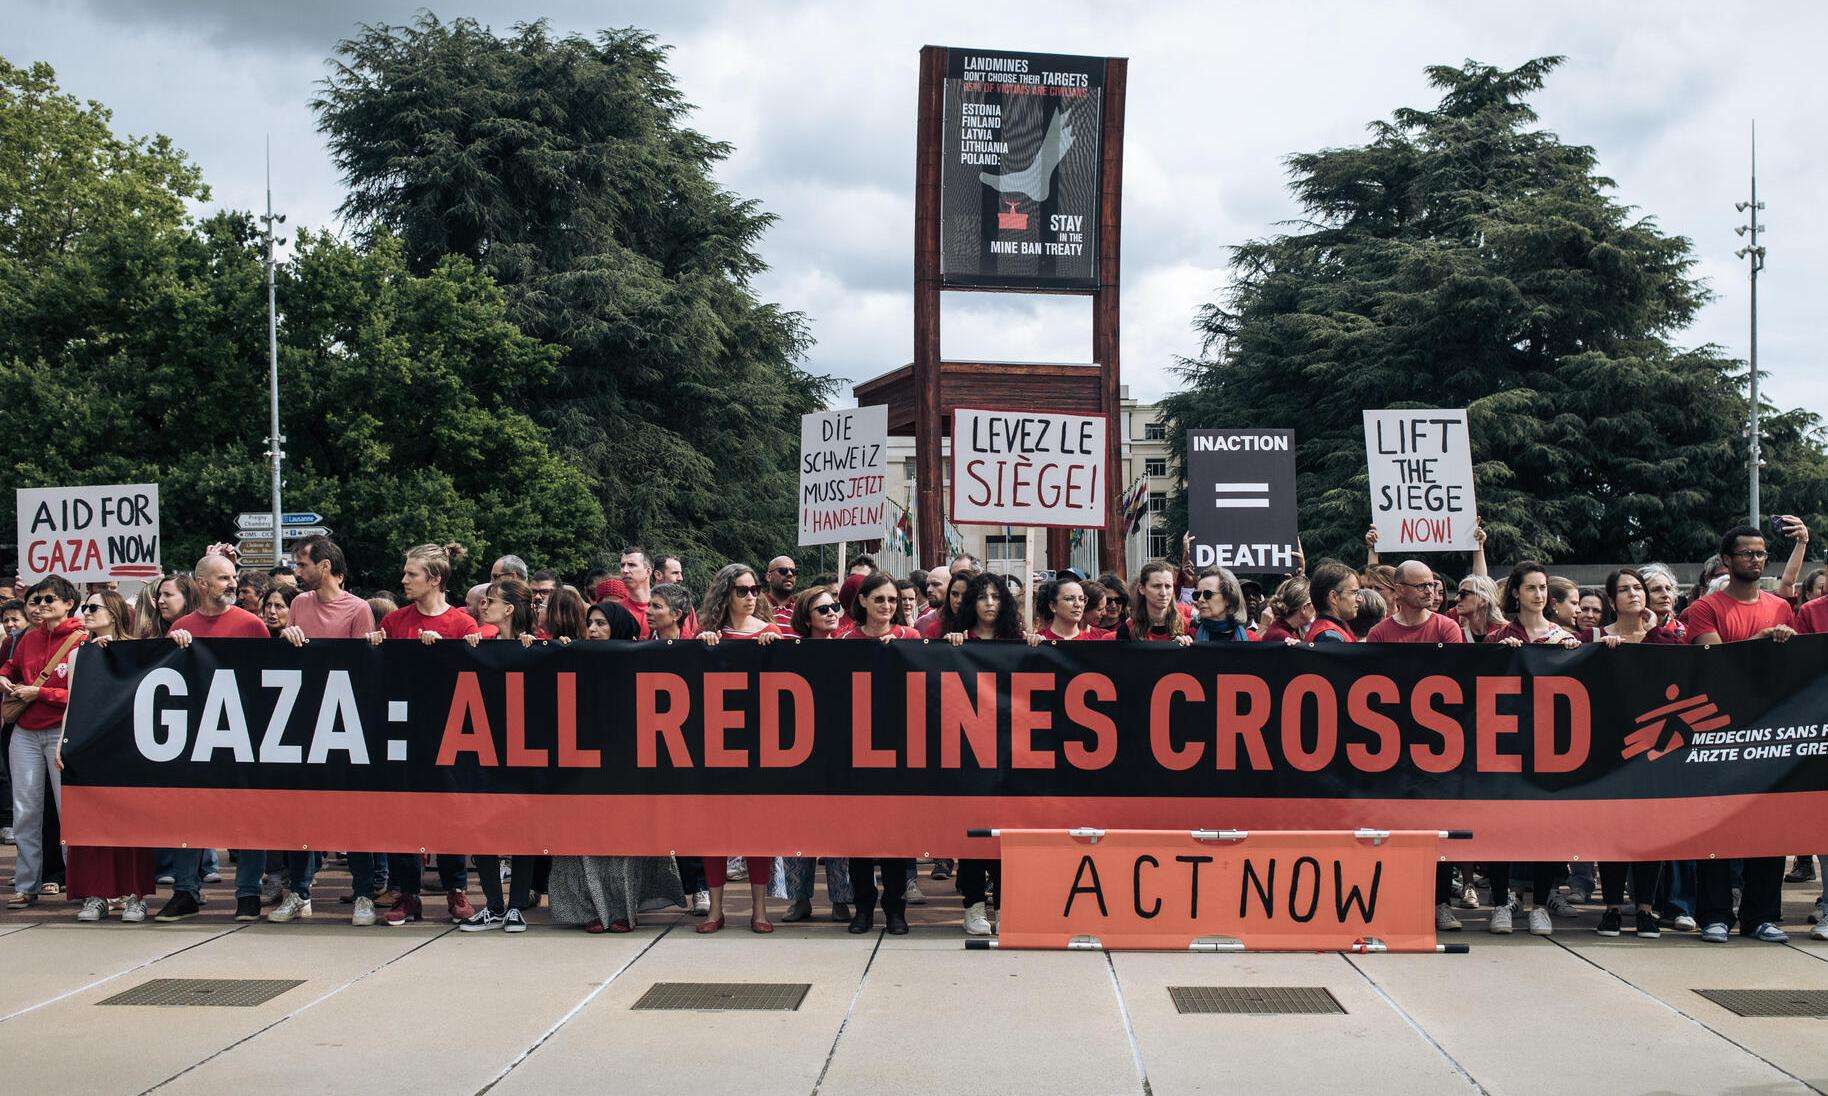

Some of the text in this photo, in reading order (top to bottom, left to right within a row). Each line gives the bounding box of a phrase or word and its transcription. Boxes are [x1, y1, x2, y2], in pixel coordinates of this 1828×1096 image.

[964, 56, 1029, 73] LANDMINES
[963, 71, 1089, 87] DON'T CHOOSE THEIR TARGETS
[962, 103, 1001, 116] ESTONIA
[962, 116, 1001, 128] FINLAND
[961, 129, 993, 140] LATVIA
[961, 141, 1009, 154] LITHUANIA
[960, 153, 1001, 165] POLAND:
[1050, 215, 1083, 232] STAY
[1059, 233, 1082, 242] IN THE
[990, 241, 1083, 256] MINE BAN TREATY
[972, 416, 1093, 455] LEVEZ LE
[1193, 436, 1288, 452] INACTION
[1377, 419, 1462, 455] LIFT
[1392, 458, 1438, 484] THE
[804, 475, 885, 504] MUSS JETZT
[967, 454, 1097, 510] SIÈGE!
[1379, 484, 1463, 512] SIEGE
[31, 494, 153, 534] AID FOR
[813, 502, 885, 534] HANDELN!
[1400, 517, 1452, 544] NOW!
[28, 534, 157, 573] GAZA NOW
[1196, 544, 1292, 567] DEATH
[435, 671, 601, 768] ALL
[635, 671, 815, 768] RED
[851, 671, 1118, 770] LINES
[1149, 672, 1592, 773] CROSSED
[1692, 728, 1772, 745] MEDECINS
[1776, 725, 1818, 740] SANS
[1685, 747, 1740, 763] ÄRZTE
[1743, 744, 1791, 760] OHNE
[1063, 855, 1383, 924] ACT NOW
